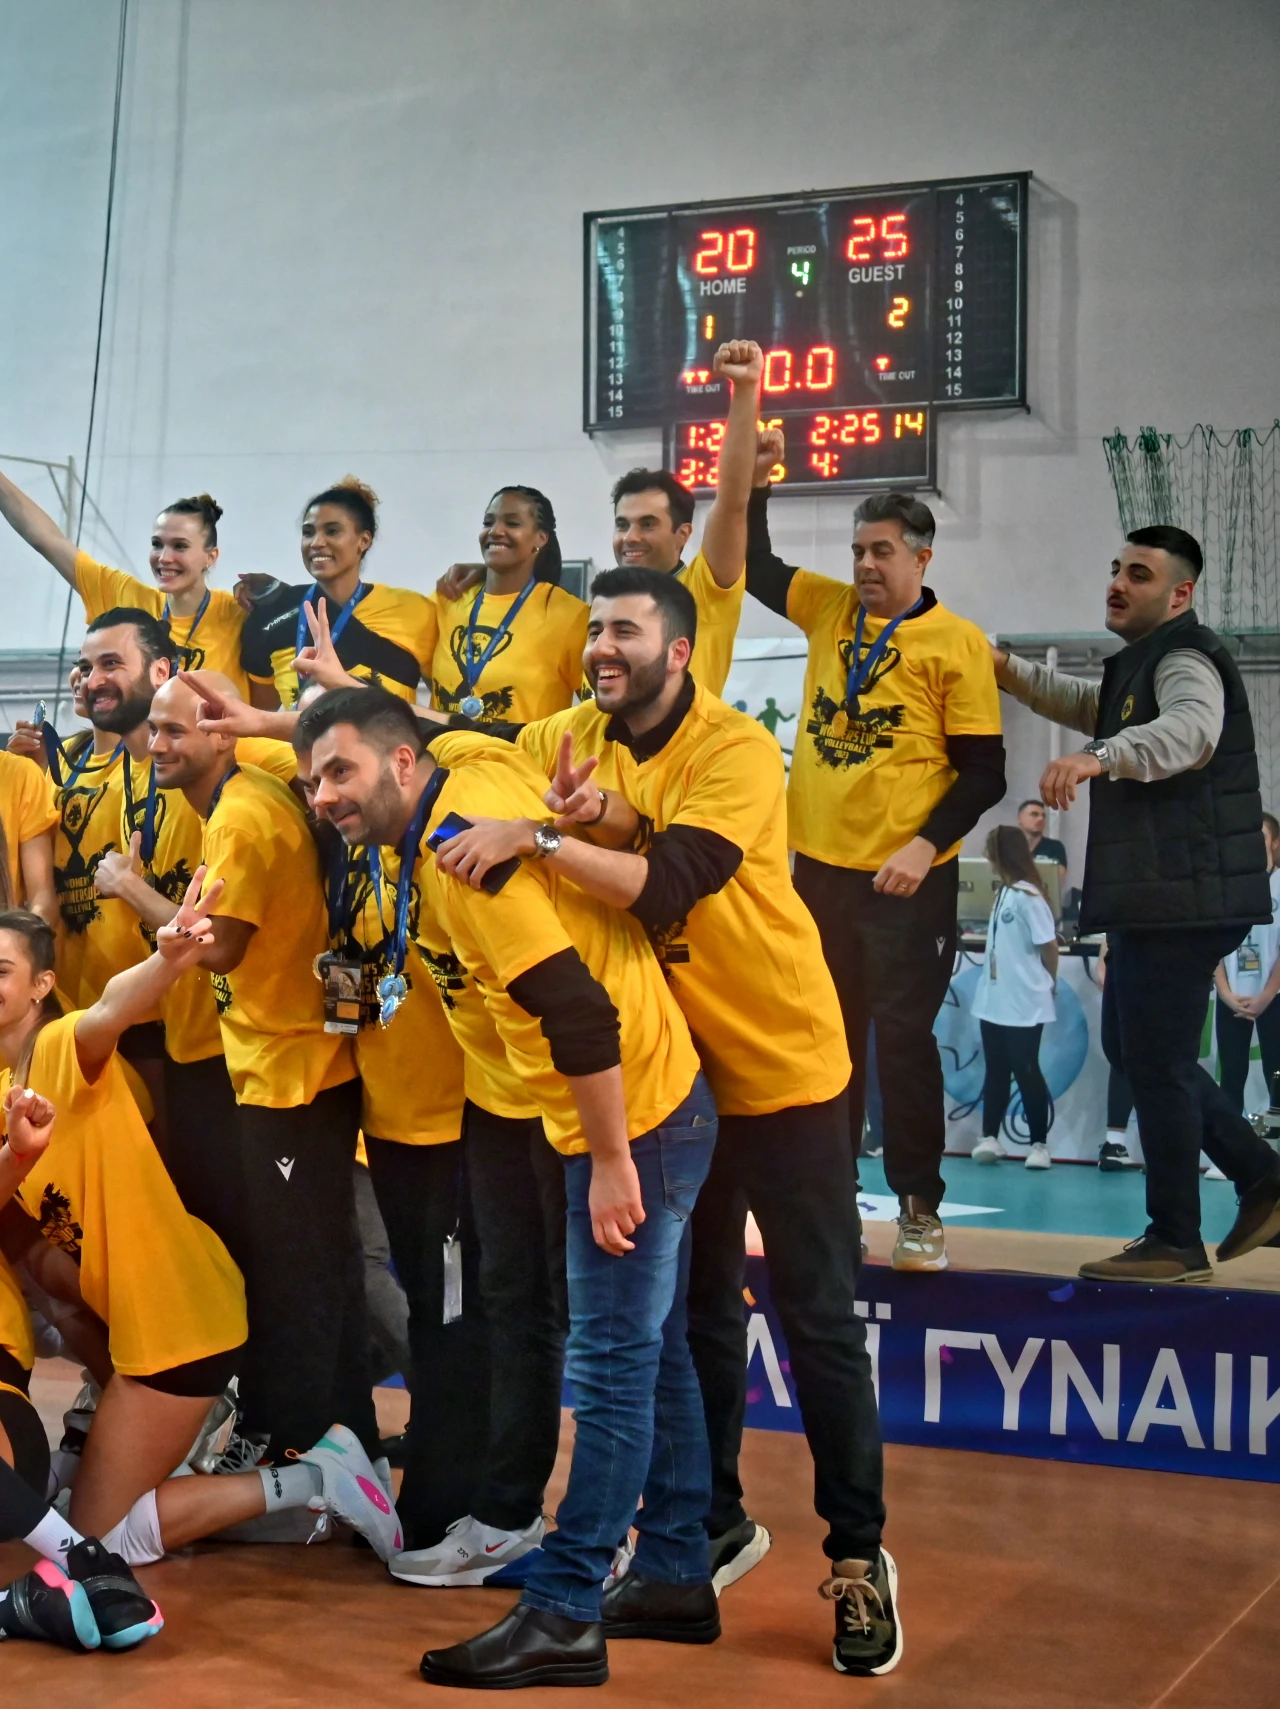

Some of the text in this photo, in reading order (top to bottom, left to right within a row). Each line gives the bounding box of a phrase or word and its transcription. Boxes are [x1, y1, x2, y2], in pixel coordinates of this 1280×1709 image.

[955, 194, 964, 206] 4
[955, 211, 964, 224] 5
[847, 214, 907, 260] 25
[955, 228, 964, 241] 6
[617, 242, 625, 255] 5
[696, 229, 755, 273] 20
[787, 245, 816, 255] PERIOD
[955, 246, 964, 258] 7
[616, 258, 625, 271] 6
[955, 262, 963, 275] 8
[791, 261, 810, 285] 4
[848, 264, 905, 284] GUEST
[700, 277, 747, 296] HOME
[954, 280, 963, 292] 9
[946, 297, 963, 310] 10
[888, 297, 909, 328] 2
[705, 314, 714, 340] 1
[947, 314, 961, 327] 11
[946, 331, 962, 344] 12
[945, 349, 962, 362] 13
[608, 357, 624, 369] 12
[608, 373, 623, 385] 13
[879, 370, 915, 381] TIME OUT
[945, 366, 962, 379] 14
[608, 389, 623, 401] 14
[685, 384, 721, 394] TIME OUT
[945, 383, 962, 396] 15
[608, 405, 623, 418] 15
[811, 413, 879, 445] 2:25
[895, 412, 923, 439] 14
[824, 738, 867, 754] VOLLEYBALL
